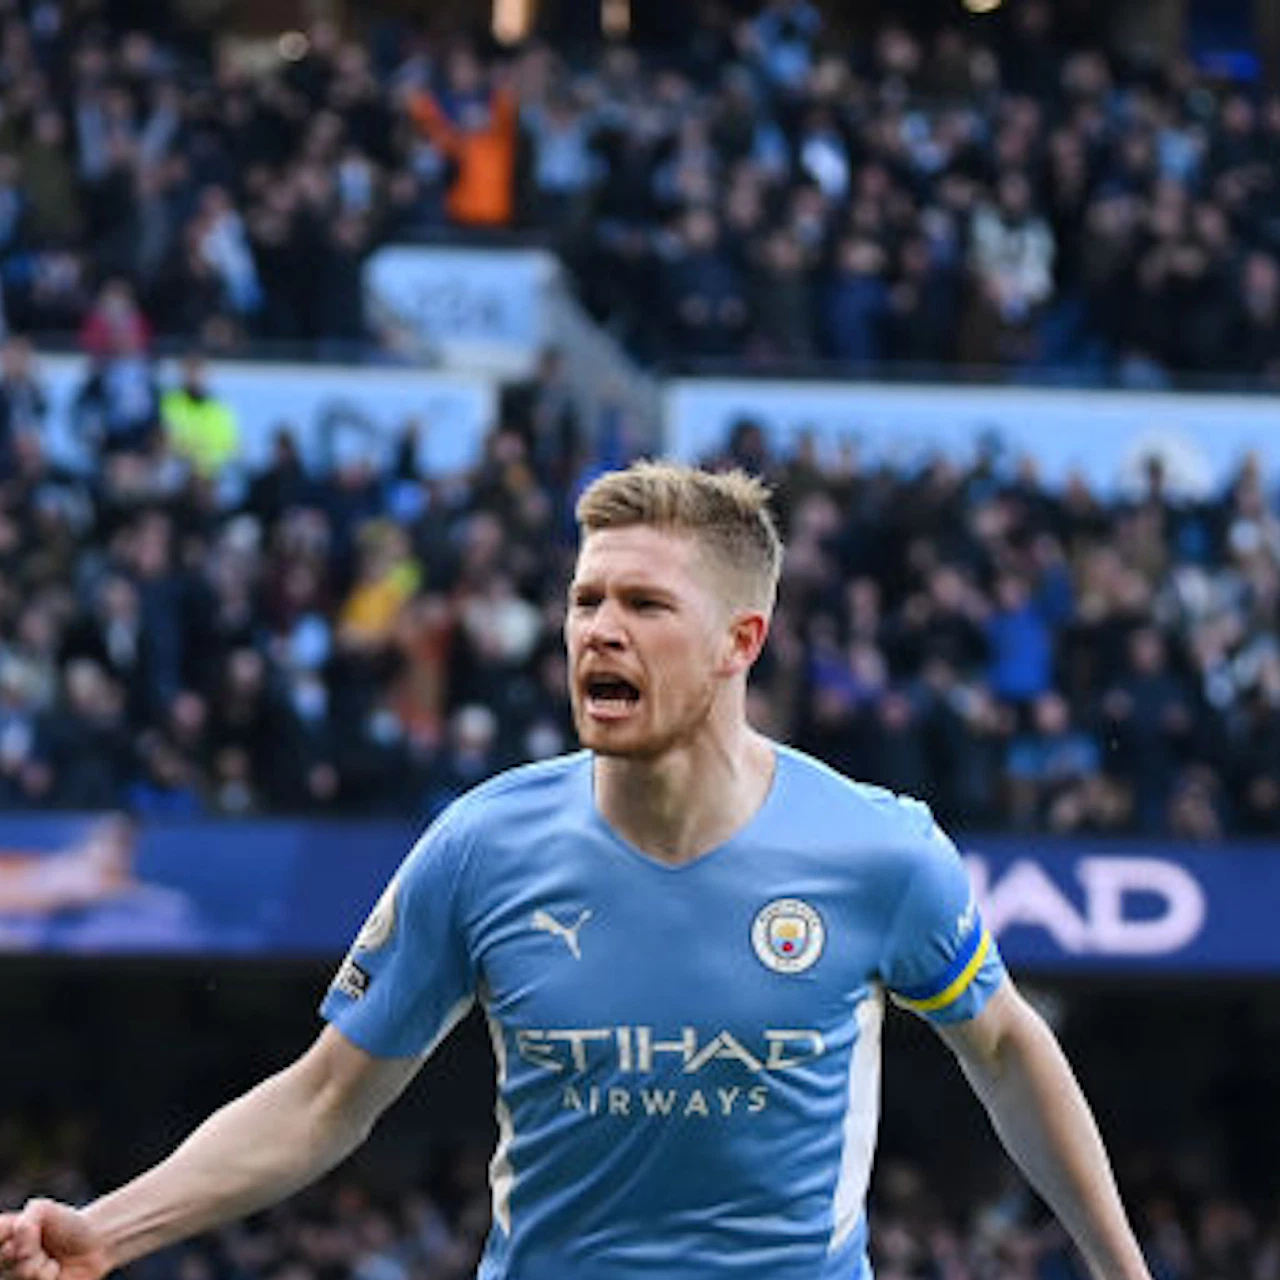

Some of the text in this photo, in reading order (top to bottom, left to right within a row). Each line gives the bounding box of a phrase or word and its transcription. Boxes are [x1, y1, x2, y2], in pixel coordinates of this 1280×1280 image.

[965, 854, 1208, 954] AD
[516, 1026, 826, 1074] ETIHAD
[562, 1085, 770, 1116] AIRWAYS
